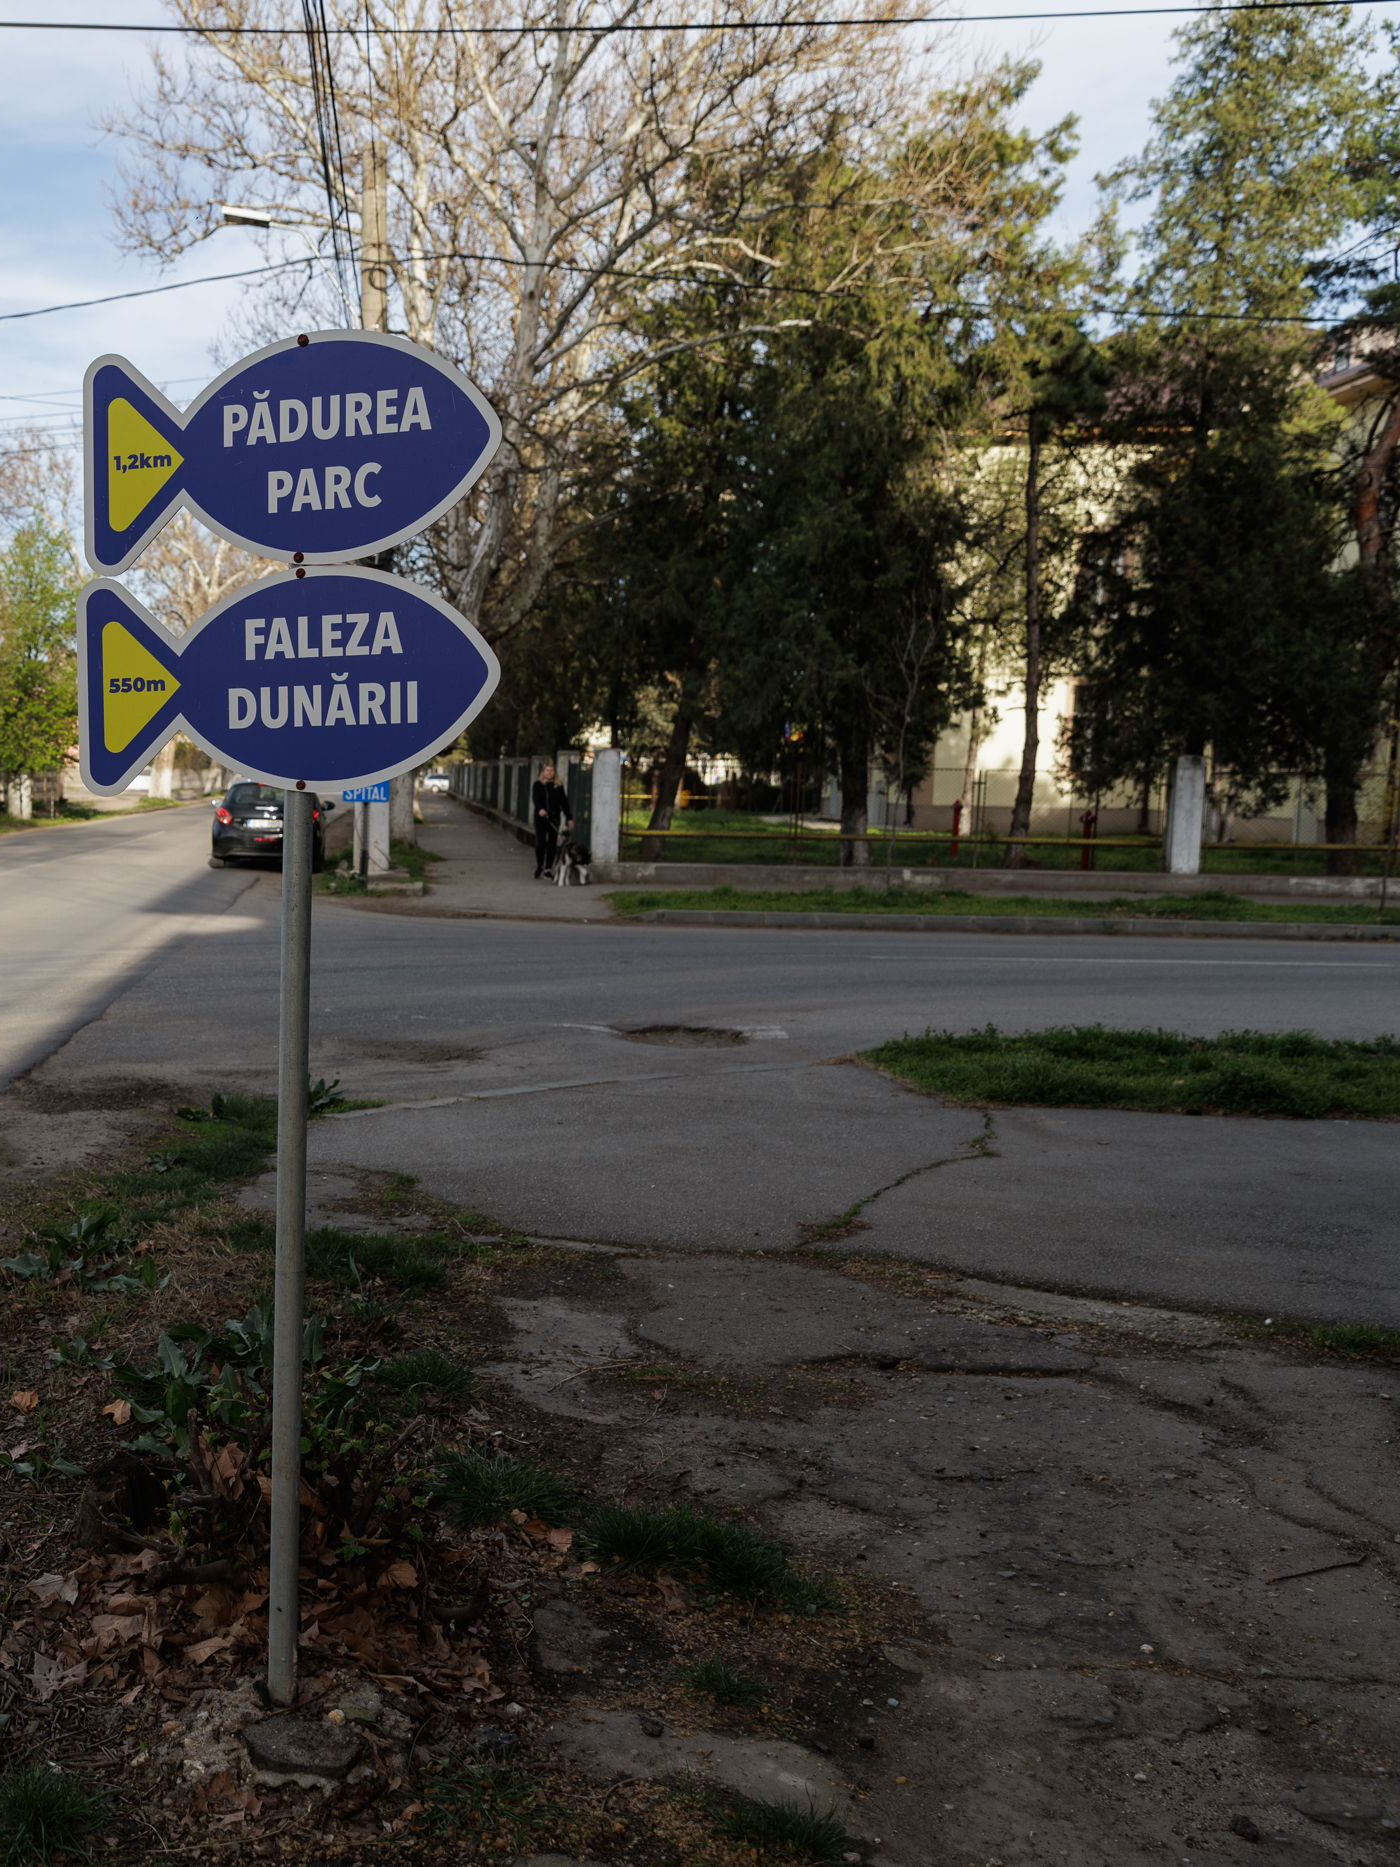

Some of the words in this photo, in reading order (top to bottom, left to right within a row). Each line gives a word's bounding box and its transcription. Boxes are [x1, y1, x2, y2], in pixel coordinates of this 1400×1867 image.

[222, 387, 432, 448] PĂDUREA
[113, 452, 172, 474] 1,2km
[267, 461, 383, 514] PARC
[244, 611, 404, 661] FALEZA
[108, 676, 167, 694] 550m
[227, 671, 419, 730] DUNĂRII
[344, 786, 388, 801] SPITAL
